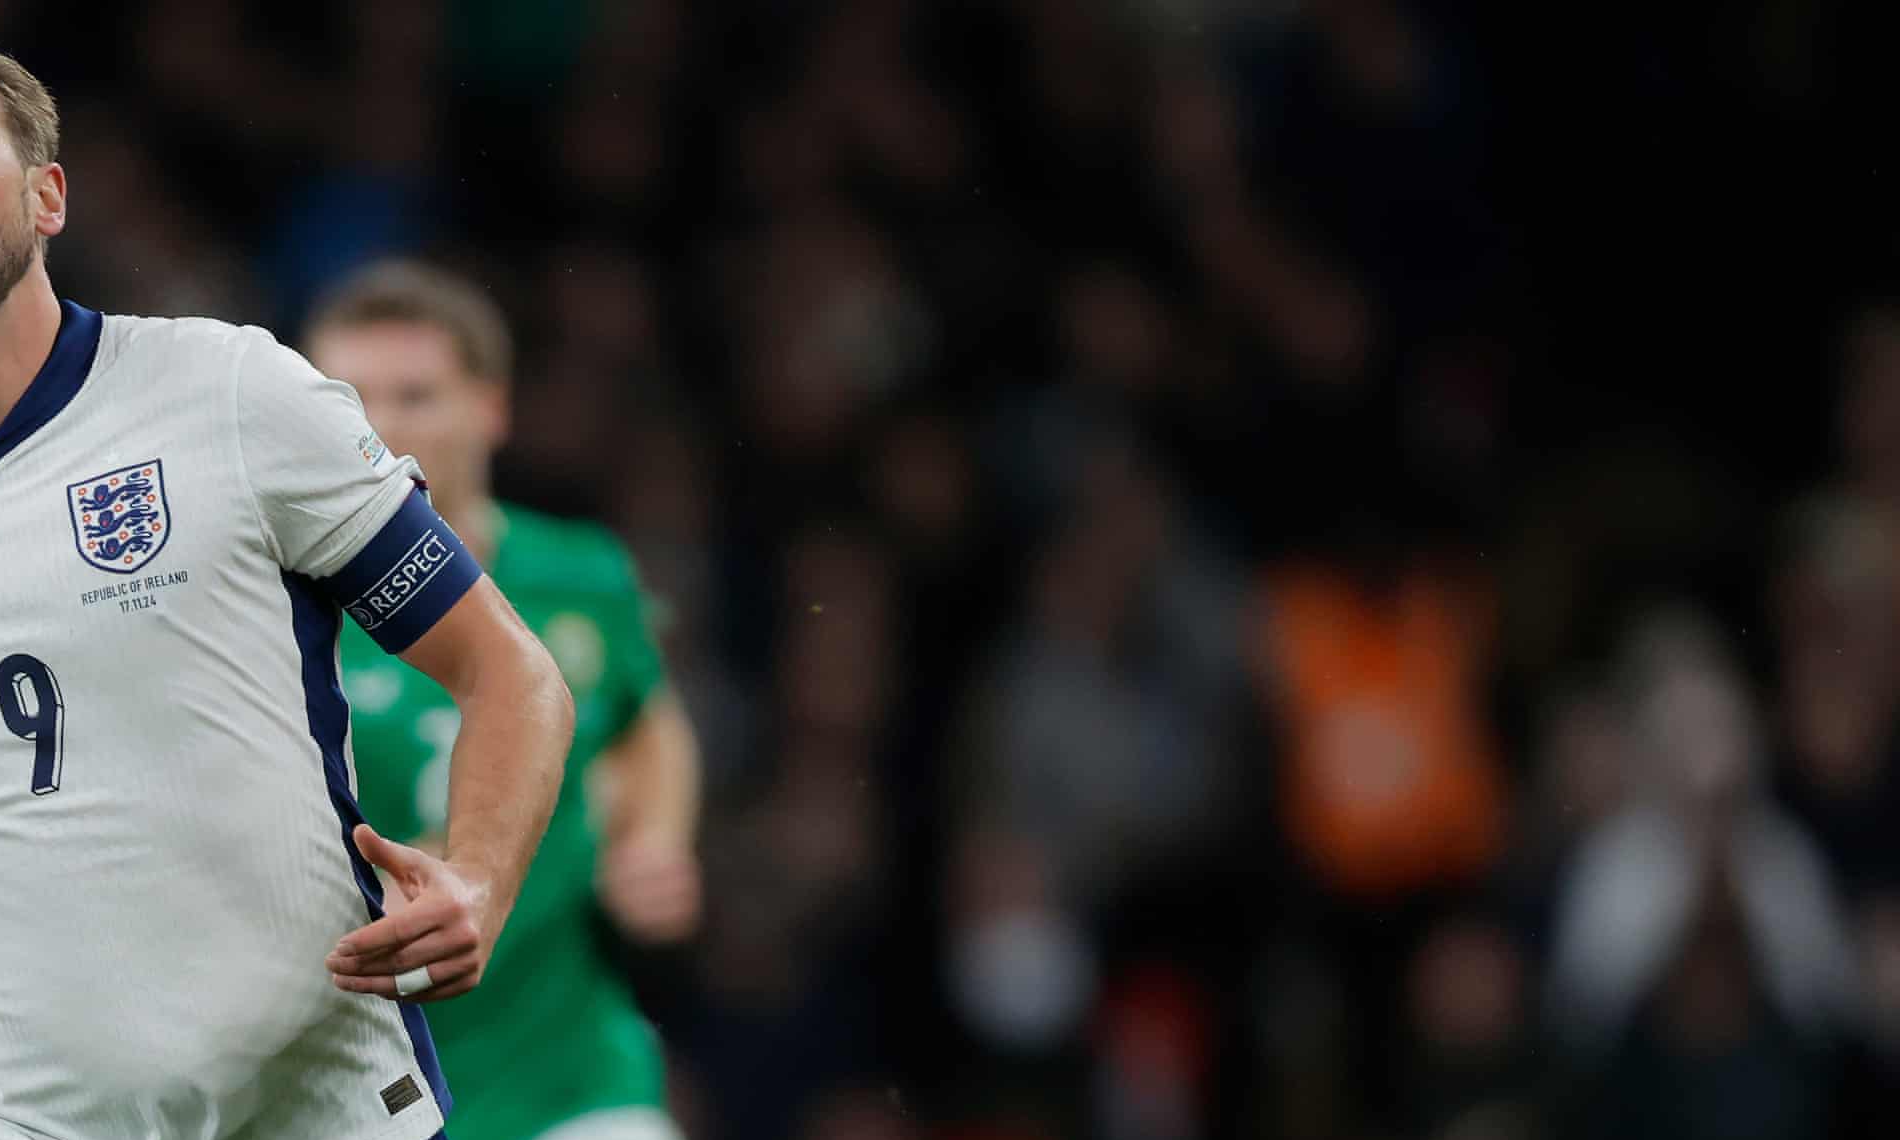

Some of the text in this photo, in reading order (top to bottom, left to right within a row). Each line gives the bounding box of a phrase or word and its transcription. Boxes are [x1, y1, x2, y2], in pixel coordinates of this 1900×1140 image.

[81, 570, 189, 606] REPUBLIC OF IRELAND
[369, 534, 447, 614] RESPECT
